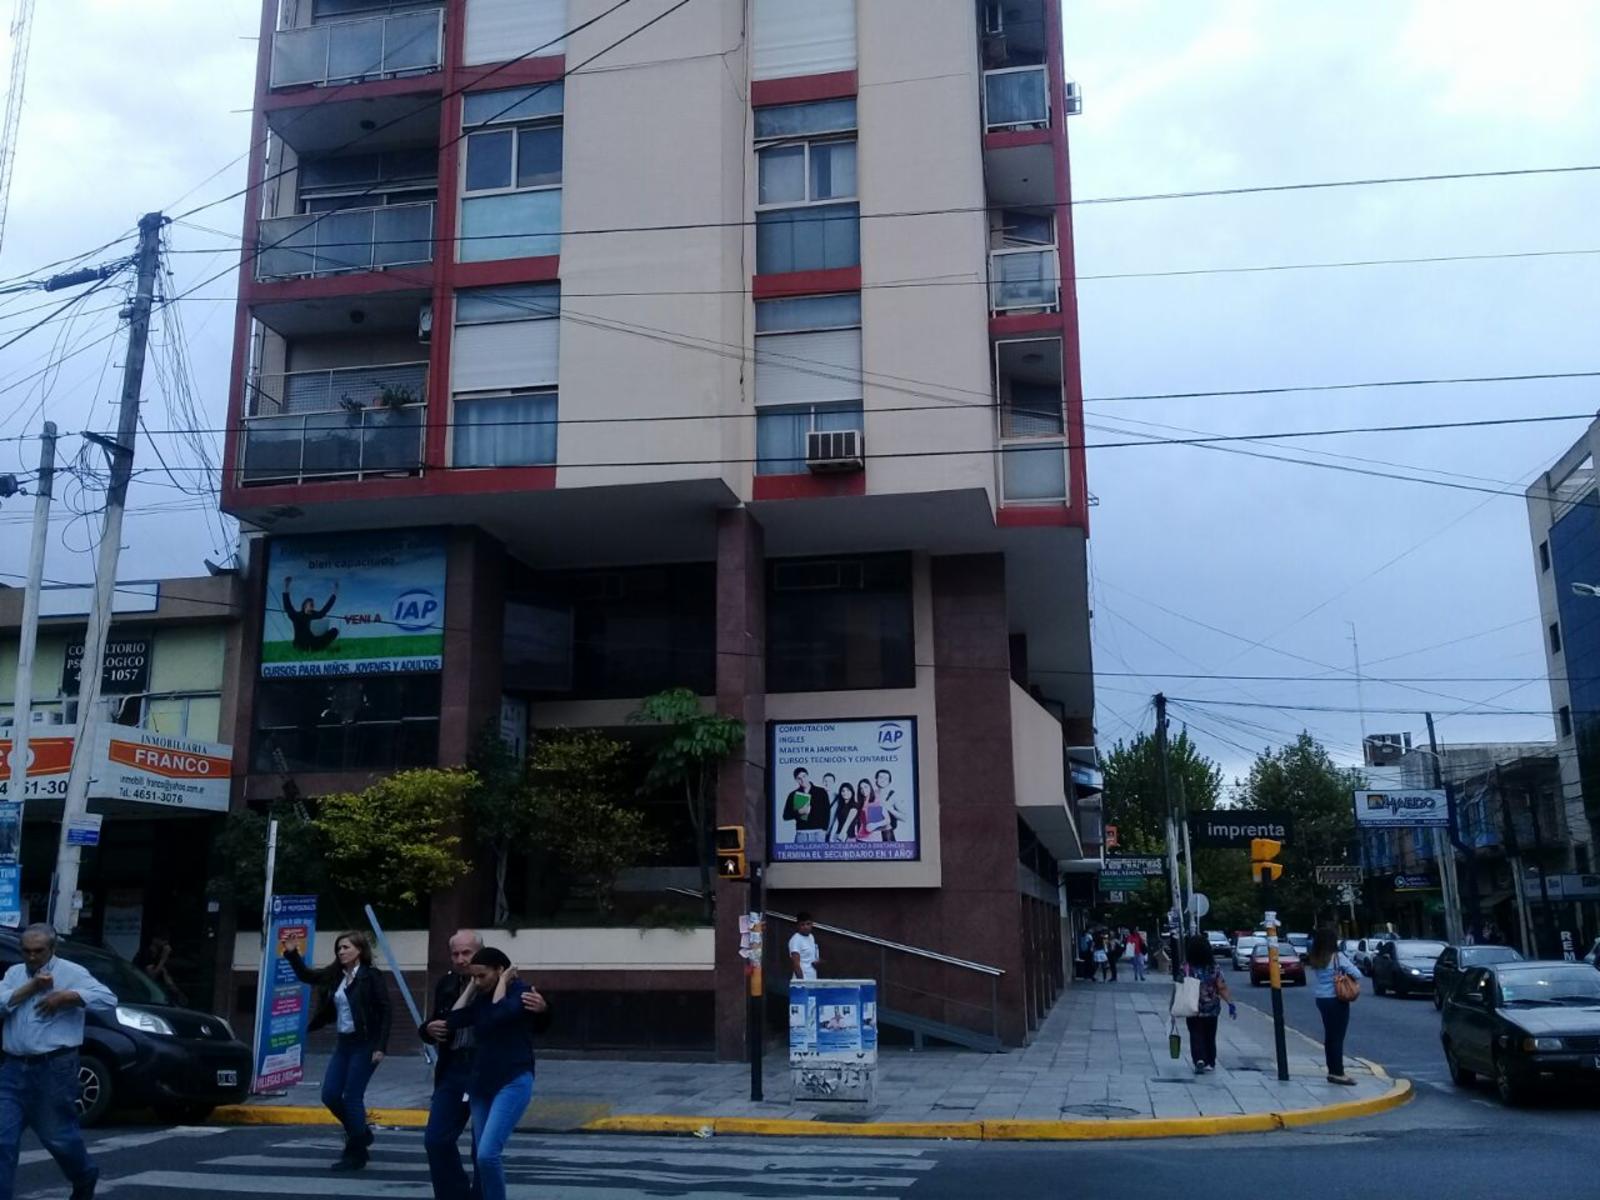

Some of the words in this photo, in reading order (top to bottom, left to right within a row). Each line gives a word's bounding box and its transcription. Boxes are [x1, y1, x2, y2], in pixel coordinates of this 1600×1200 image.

[394, 598, 438, 621] IAP
[68, 643, 146, 655] COLTORIO
[263, 665, 297, 677] CURSOS
[299, 664, 321, 675] PARA
[355, 661, 391, 673] JOVENES
[393, 660, 401, 671] Y
[401, 658, 439, 670] ADULTOS
[779, 725, 836, 733] COMPUTACION
[878, 730, 904, 743] IAP
[779, 736, 805, 744] INGLES
[140, 734, 208, 754] INMOBILIARIA
[779, 746, 815, 754] MAESTRA
[816, 745, 859, 753] JARDINERA
[134, 748, 210, 774] FRANCO
[779, 757, 808, 765] CURSOS
[855, 755, 899, 763] CONTABLES
[132, 789, 184, 804] 4651-3076
[1207, 822, 1286, 840] imprenta
[824, 850, 874, 859] SECUNDARIO
